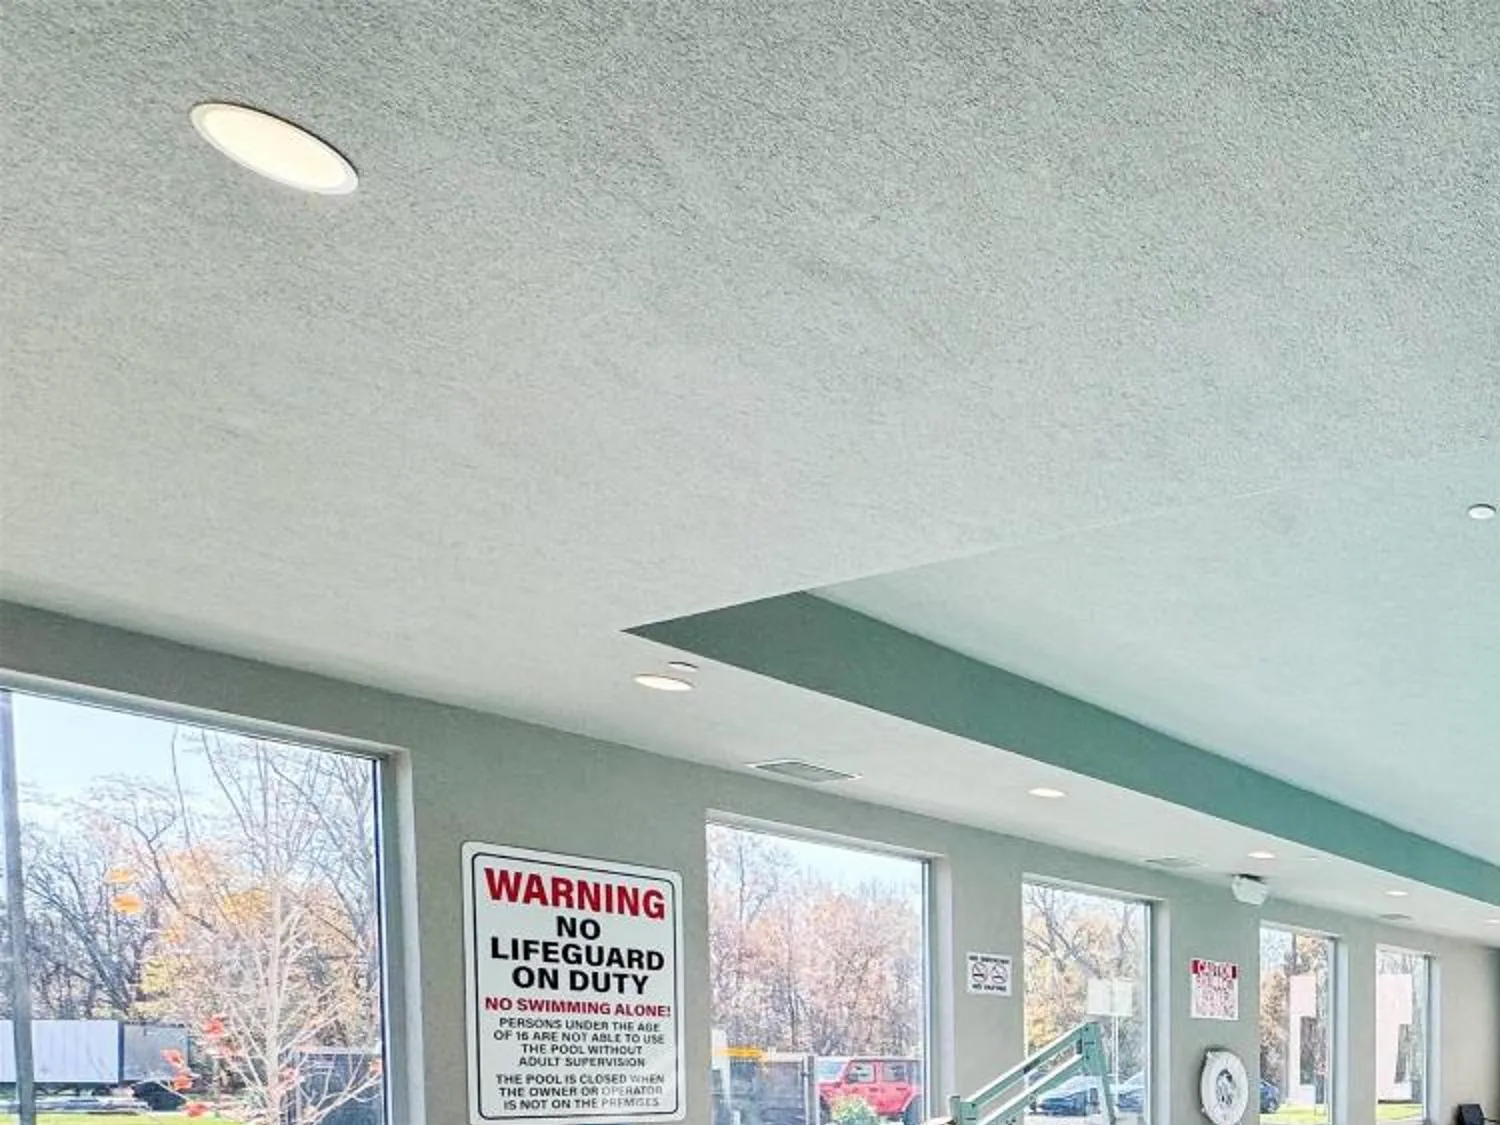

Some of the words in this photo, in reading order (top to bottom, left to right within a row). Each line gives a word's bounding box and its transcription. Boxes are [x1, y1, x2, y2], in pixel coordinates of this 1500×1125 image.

[484, 867, 665, 920] WARNING
[556, 916, 601, 940] NO
[491, 936, 665, 971] LIFEGUARD
[512, 966, 558, 990] ON
[569, 969, 649, 995] DUTY
[485, 997, 513, 1011] NO
[517, 999, 611, 1016] SWIMMING
[614, 1003, 671, 1017] ALONE!
[499, 1017, 562, 1030] PERSONS
[565, 1019, 609, 1030] UNDER
[612, 1021, 634, 1031] THE
[637, 1022, 660, 1033] AGE
[493, 1030, 513, 1041] OF
[516, 1031, 529, 1041] 16
[533, 1032, 558, 1042] ARE
[562, 1032, 589, 1043] NOT
[591, 1033, 622, 1043] ABLE
[625, 1033, 640, 1044] TO
[643, 1034, 665, 1045] USE
[521, 1043, 546, 1054] THE
[551, 1044, 585, 1055] POOL
[588, 1045, 643, 1055] WITHOUT
[518, 1056, 561, 1067] ADULT
[565, 1057, 646, 1067] SUPERVISION
[496, 1074, 522, 1085] THE
[525, 1074, 562, 1085] POOL
[565, 1074, 577, 1085] IS
[579, 1074, 627, 1085] CLOSED
[629, 1073, 665, 1083] WHEN
[499, 1087, 524, 1097] THE
[529, 1087, 577, 1097] OWNER
[581, 1086, 598, 1096] OR
[601, 1085, 663, 1095] OPERATOR
[504, 1100, 517, 1111] IS
[520, 1099, 547, 1110] NOT
[551, 1099, 571, 1109] ON
[575, 1098, 599, 1108] THE
[601, 1097, 660, 1107] PREMISES
